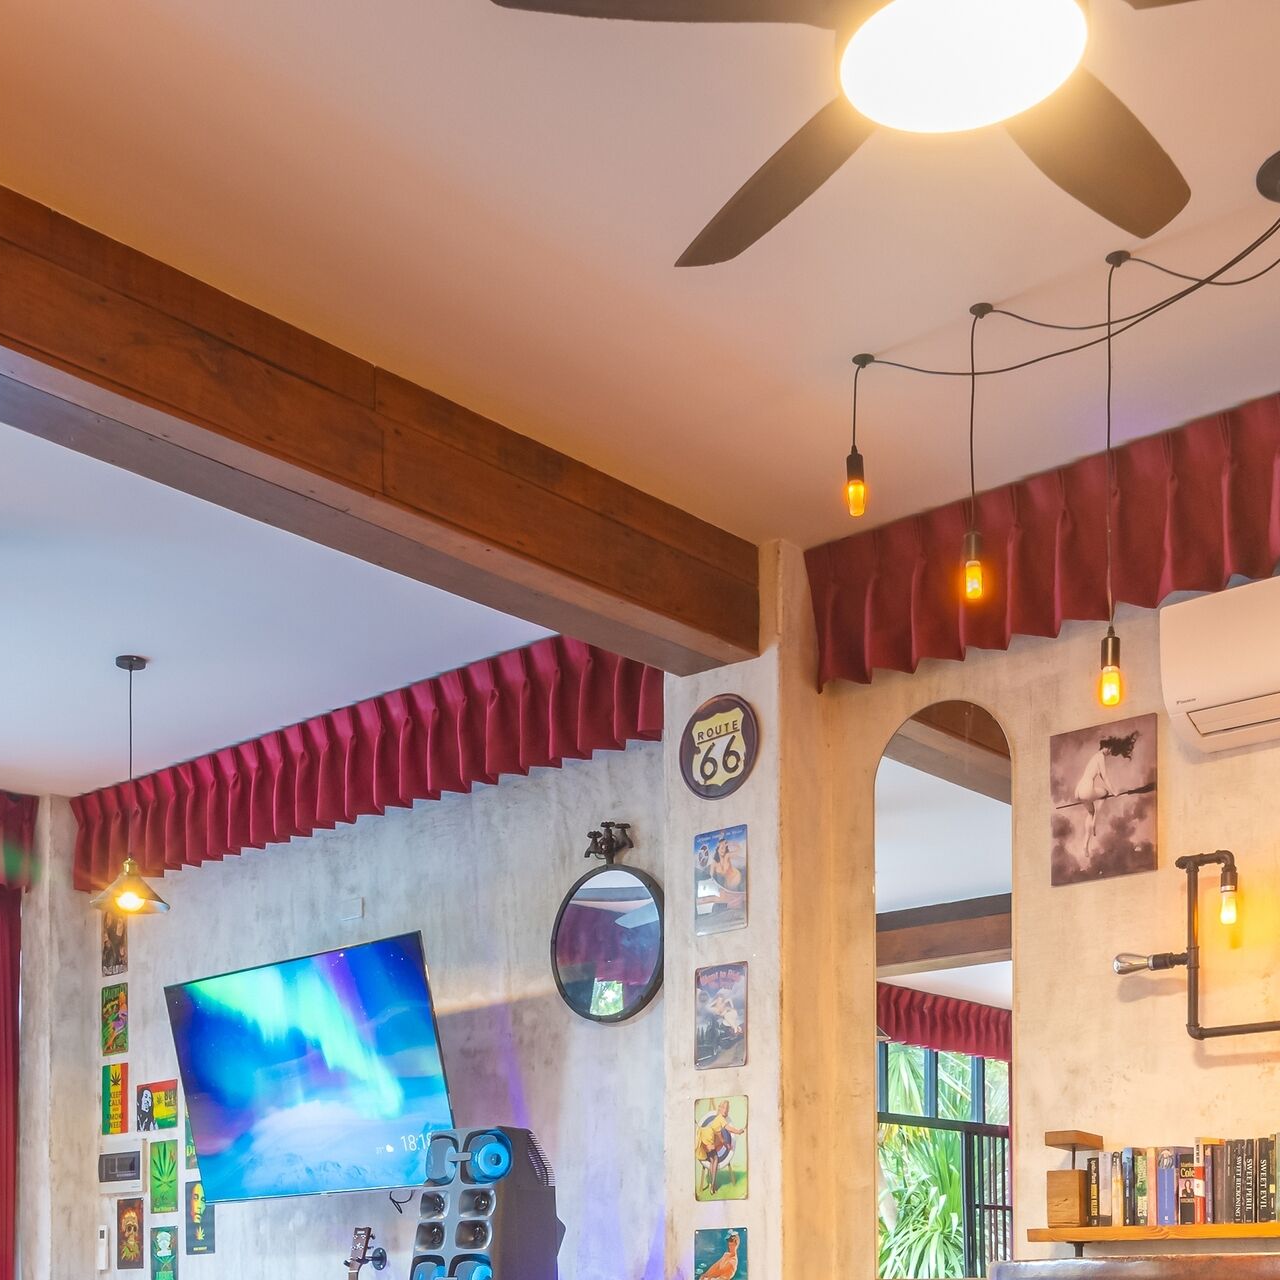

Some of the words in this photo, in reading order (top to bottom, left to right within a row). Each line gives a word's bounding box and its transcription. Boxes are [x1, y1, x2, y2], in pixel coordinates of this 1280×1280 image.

[697, 719, 740, 742] ROUTE
[699, 735, 741, 783] 66
[1245, 1187, 1253, 1211] PERIL
